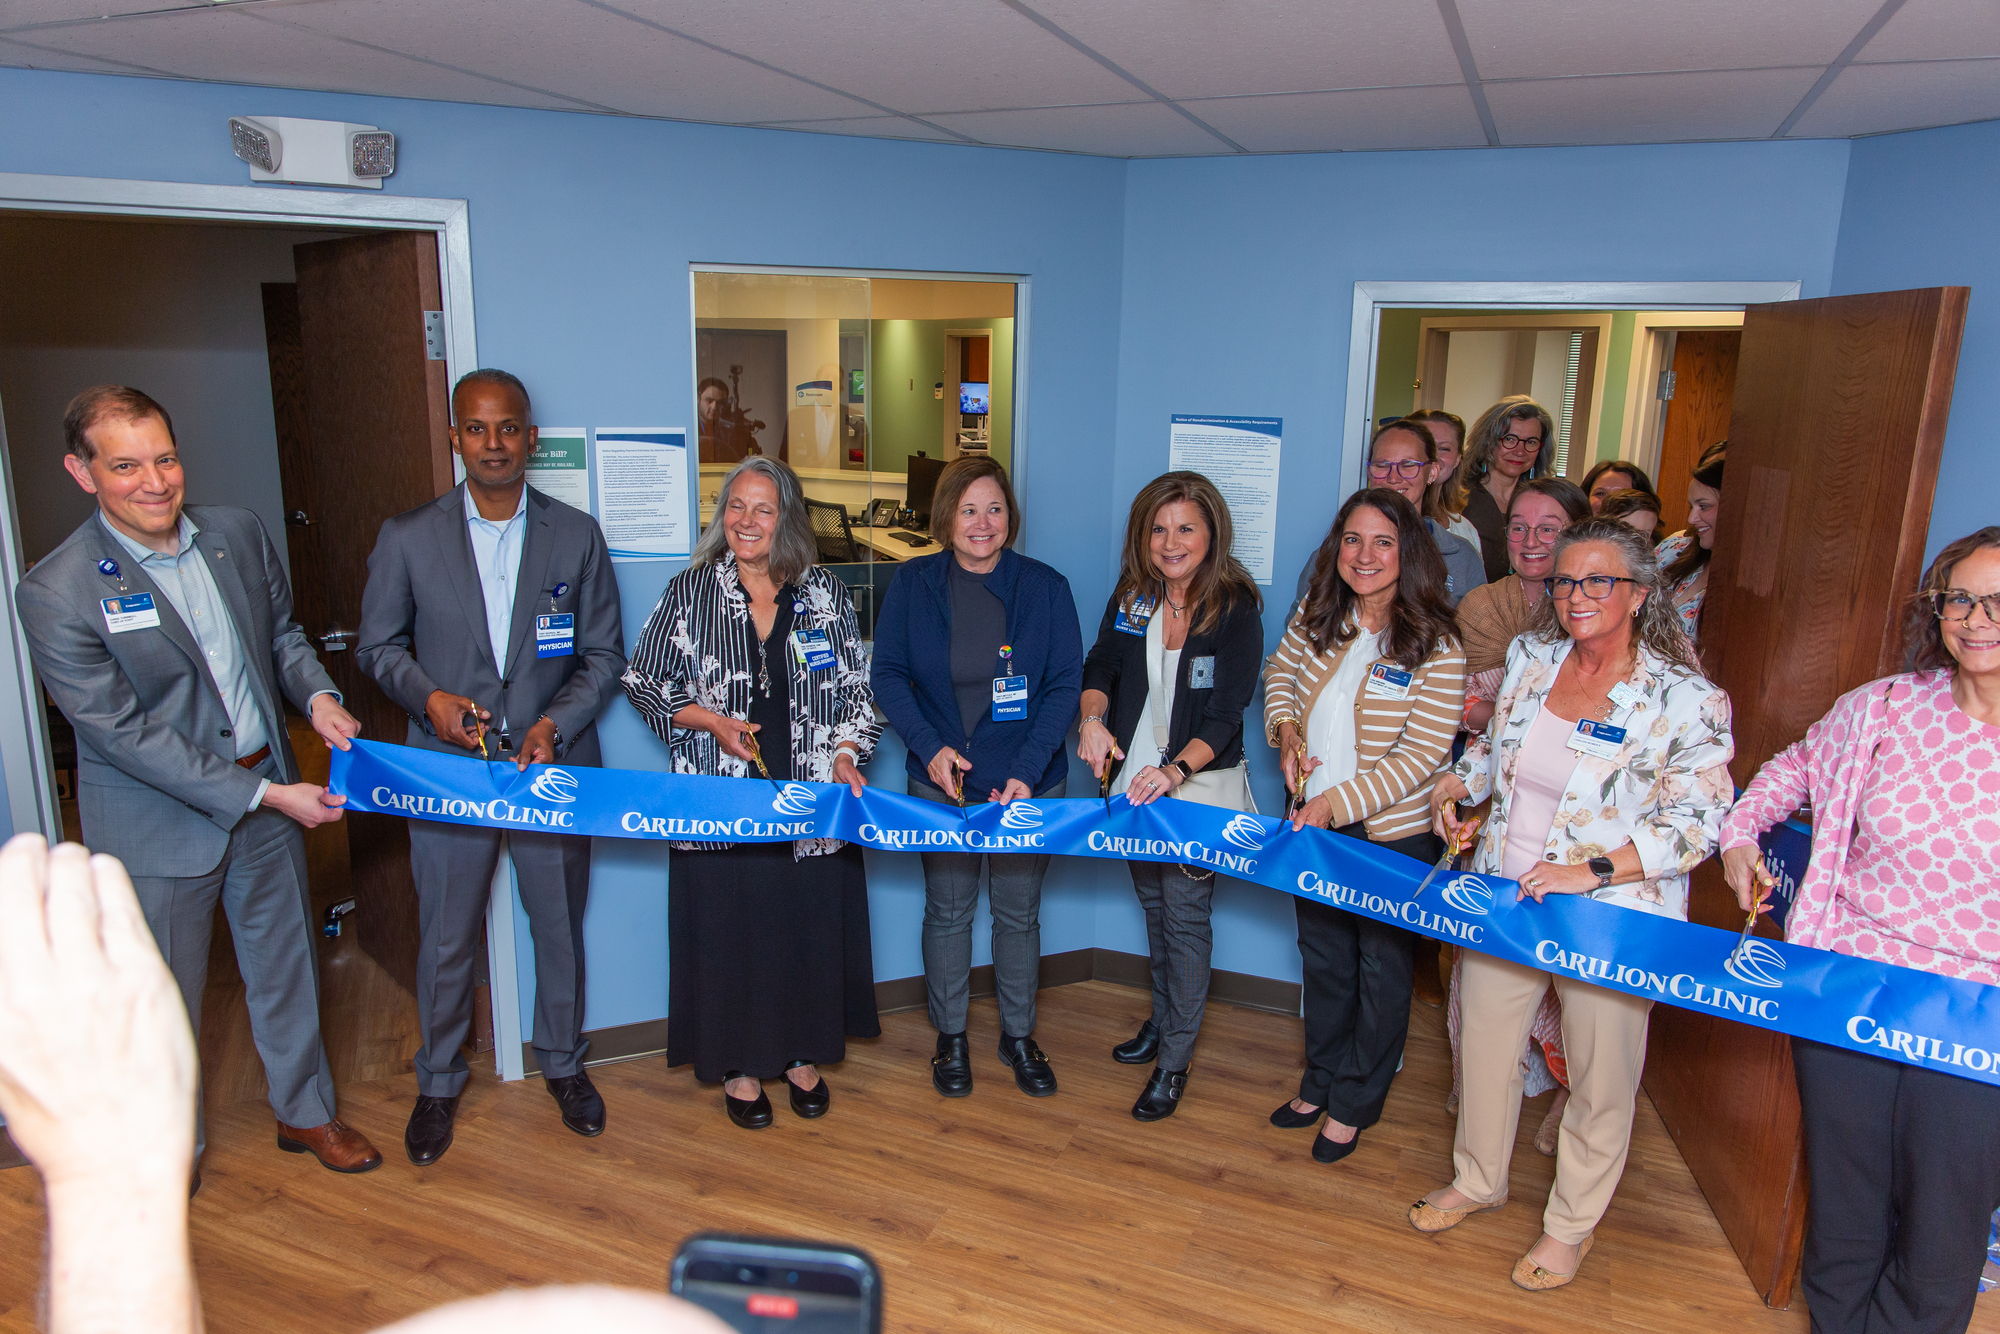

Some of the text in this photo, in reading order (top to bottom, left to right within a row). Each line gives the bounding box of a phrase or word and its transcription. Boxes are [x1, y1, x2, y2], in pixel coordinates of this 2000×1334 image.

[550, 450, 568, 458] Bill?
[538, 641, 573, 652] PHYSICIAN
[997, 706, 1021, 714] PHYSICIAN
